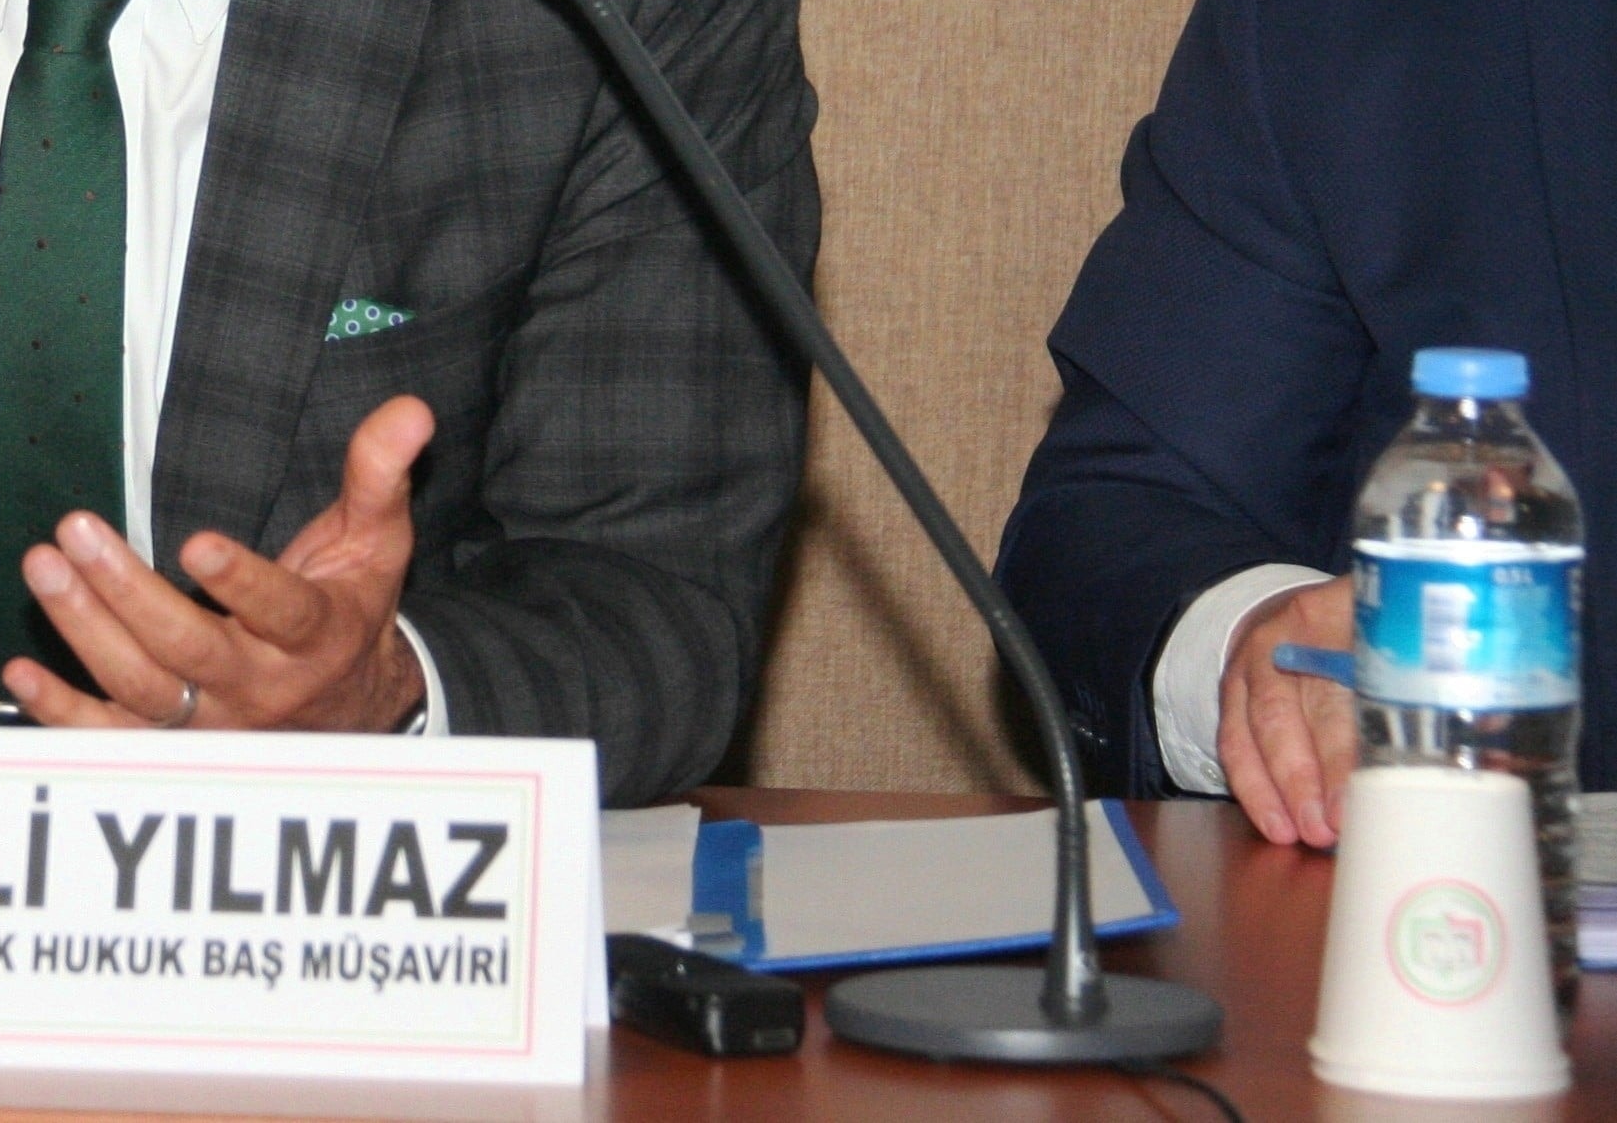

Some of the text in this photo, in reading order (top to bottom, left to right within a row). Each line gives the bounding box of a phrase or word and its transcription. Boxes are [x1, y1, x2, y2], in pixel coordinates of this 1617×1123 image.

[96, 813, 510, 921] YILMAZ
[32, 936, 185, 976] HUKUK
[202, 939, 284, 990] BAŞ
[300, 932, 511, 992] MÜŞAVİRİ
